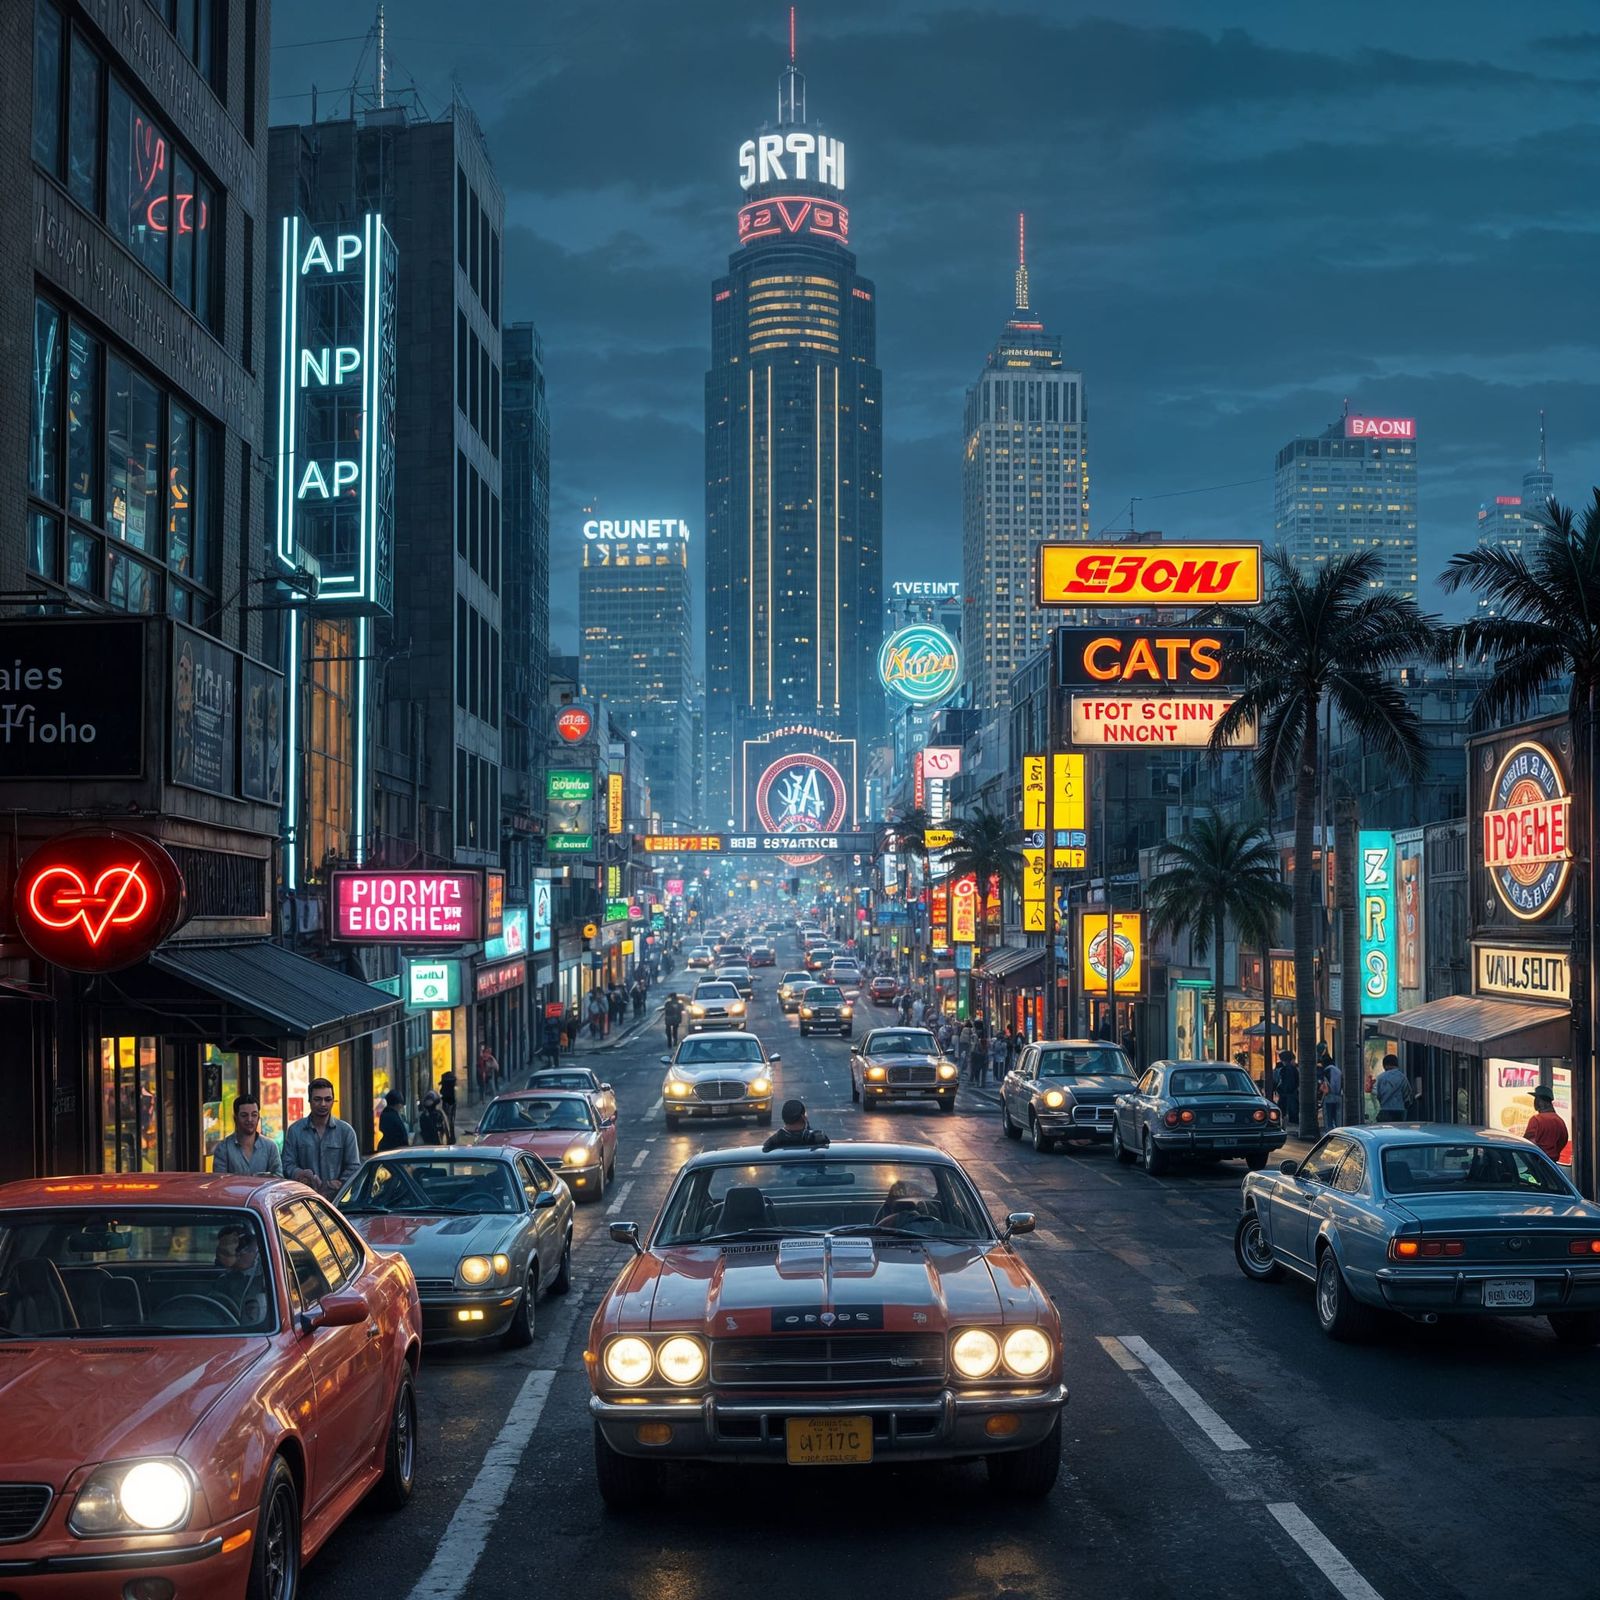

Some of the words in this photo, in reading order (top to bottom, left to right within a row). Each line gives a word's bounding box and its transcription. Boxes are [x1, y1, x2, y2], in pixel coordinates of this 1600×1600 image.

[301, 235, 363, 275] AP
[300, 347, 362, 388] NP
[297, 460, 359, 499] AP
